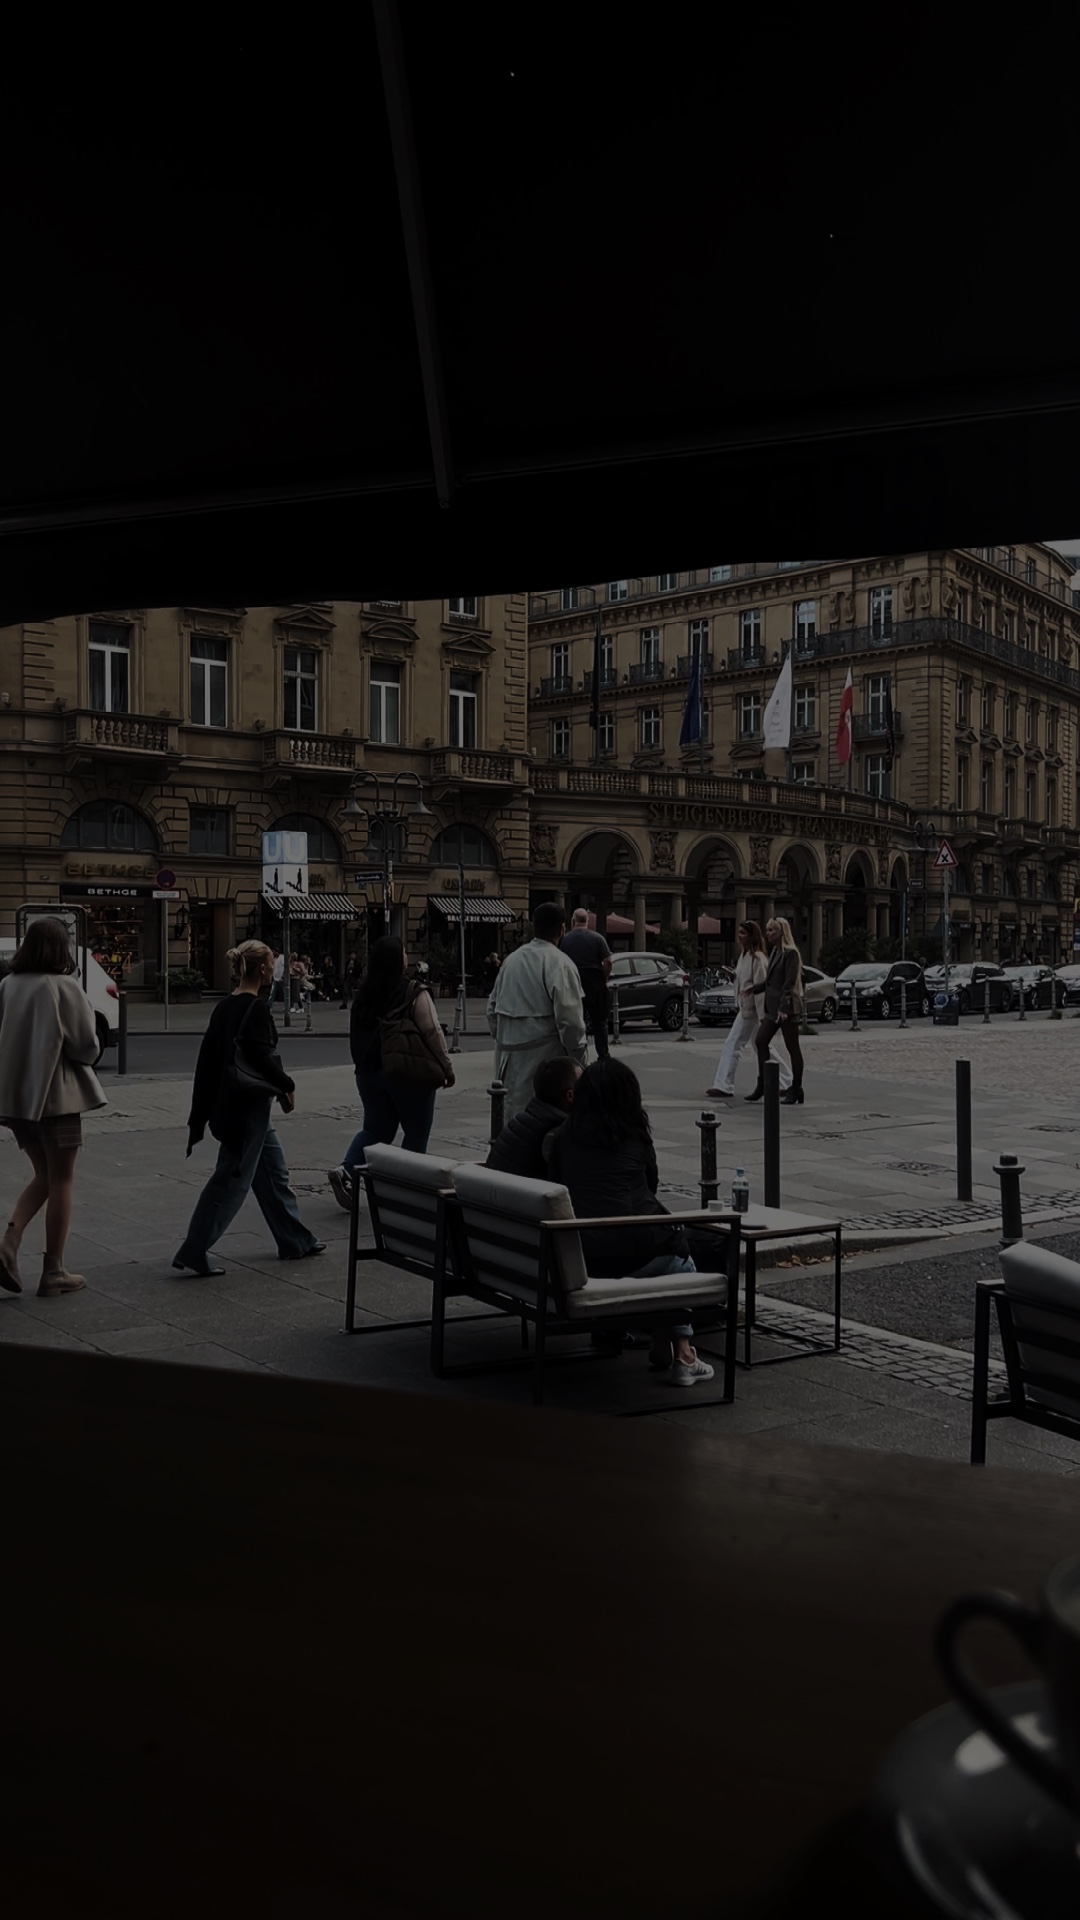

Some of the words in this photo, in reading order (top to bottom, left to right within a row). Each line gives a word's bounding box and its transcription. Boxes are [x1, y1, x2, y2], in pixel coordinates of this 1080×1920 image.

[649, 803, 787, 829] STEIGENBERGER
[797, 815, 876, 840] FRANKFURTER
[263, 833, 282, 861] U
[283, 833, 306, 862] U
[66, 863, 157, 878] BETHGE
[87, 888, 138, 896] BETHGE
[278, 912, 318, 920] BASSERIE
[319, 912, 355, 921] MODERNE
